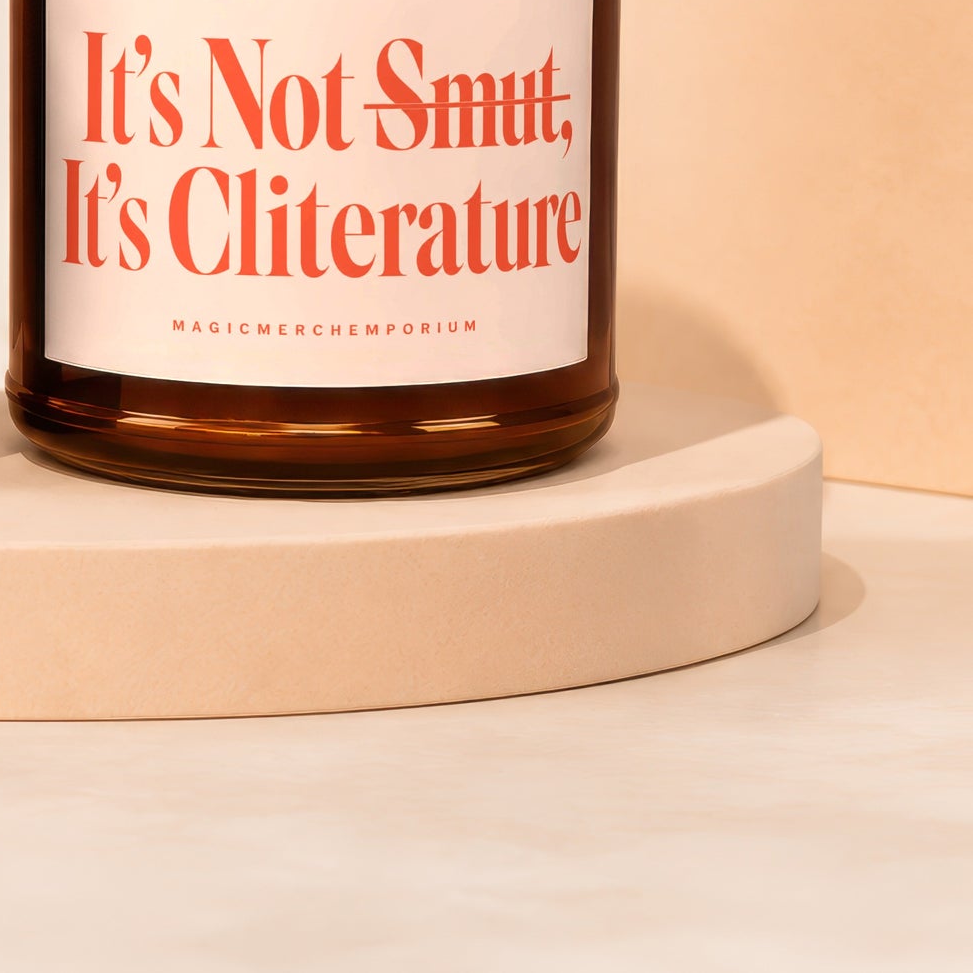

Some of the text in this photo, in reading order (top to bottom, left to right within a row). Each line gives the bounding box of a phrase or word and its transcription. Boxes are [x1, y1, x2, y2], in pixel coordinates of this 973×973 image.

[82, 30, 575, 158] It’s Not Smut,
[61, 157, 583, 279] It’s Cliterature
[172, 319, 477, 337] MAGICMERCHEMPORIUM
